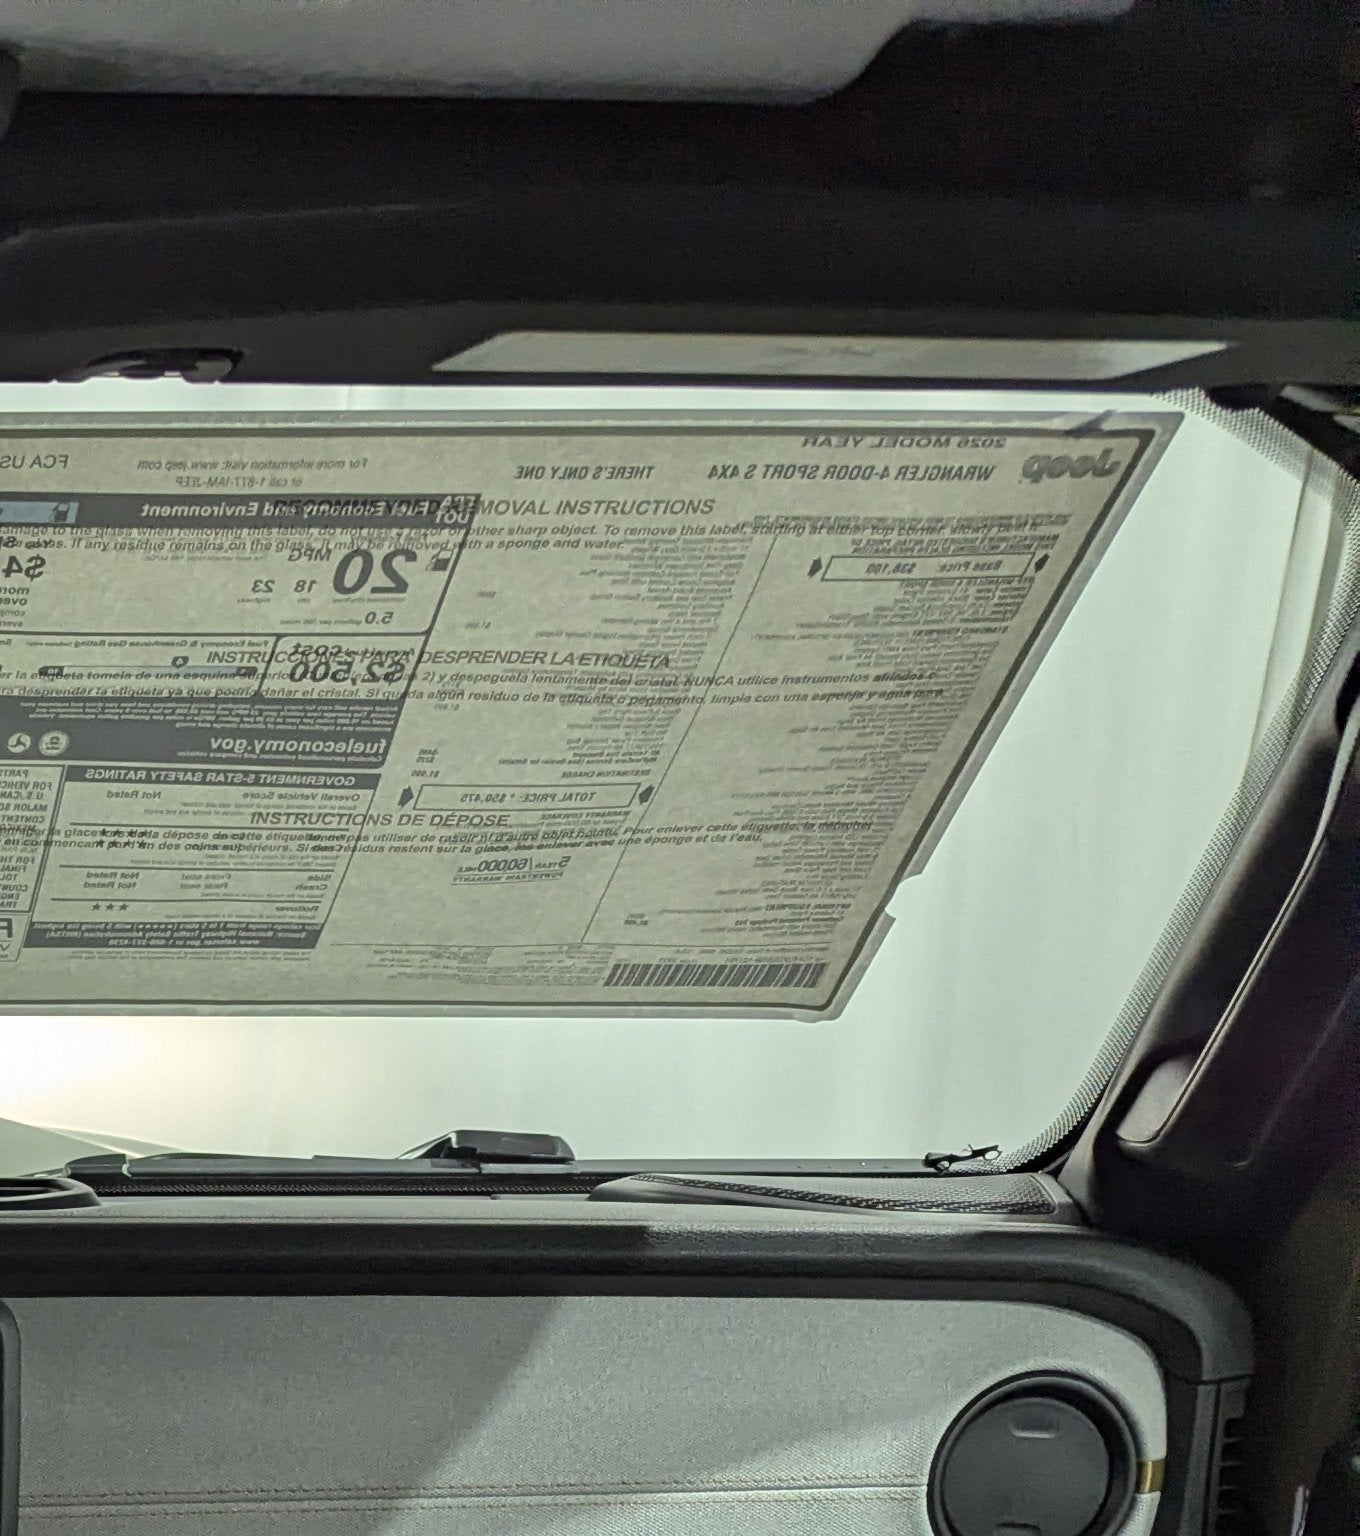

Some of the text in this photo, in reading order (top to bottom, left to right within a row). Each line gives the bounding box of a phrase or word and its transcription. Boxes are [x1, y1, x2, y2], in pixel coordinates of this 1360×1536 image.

[555, 499, 716, 516] INSTRUCTIONS
[419, 651, 547, 665] DESPRENDER
[250, 811, 510, 827] INSTRUCTIONS DE DÉPOSE
